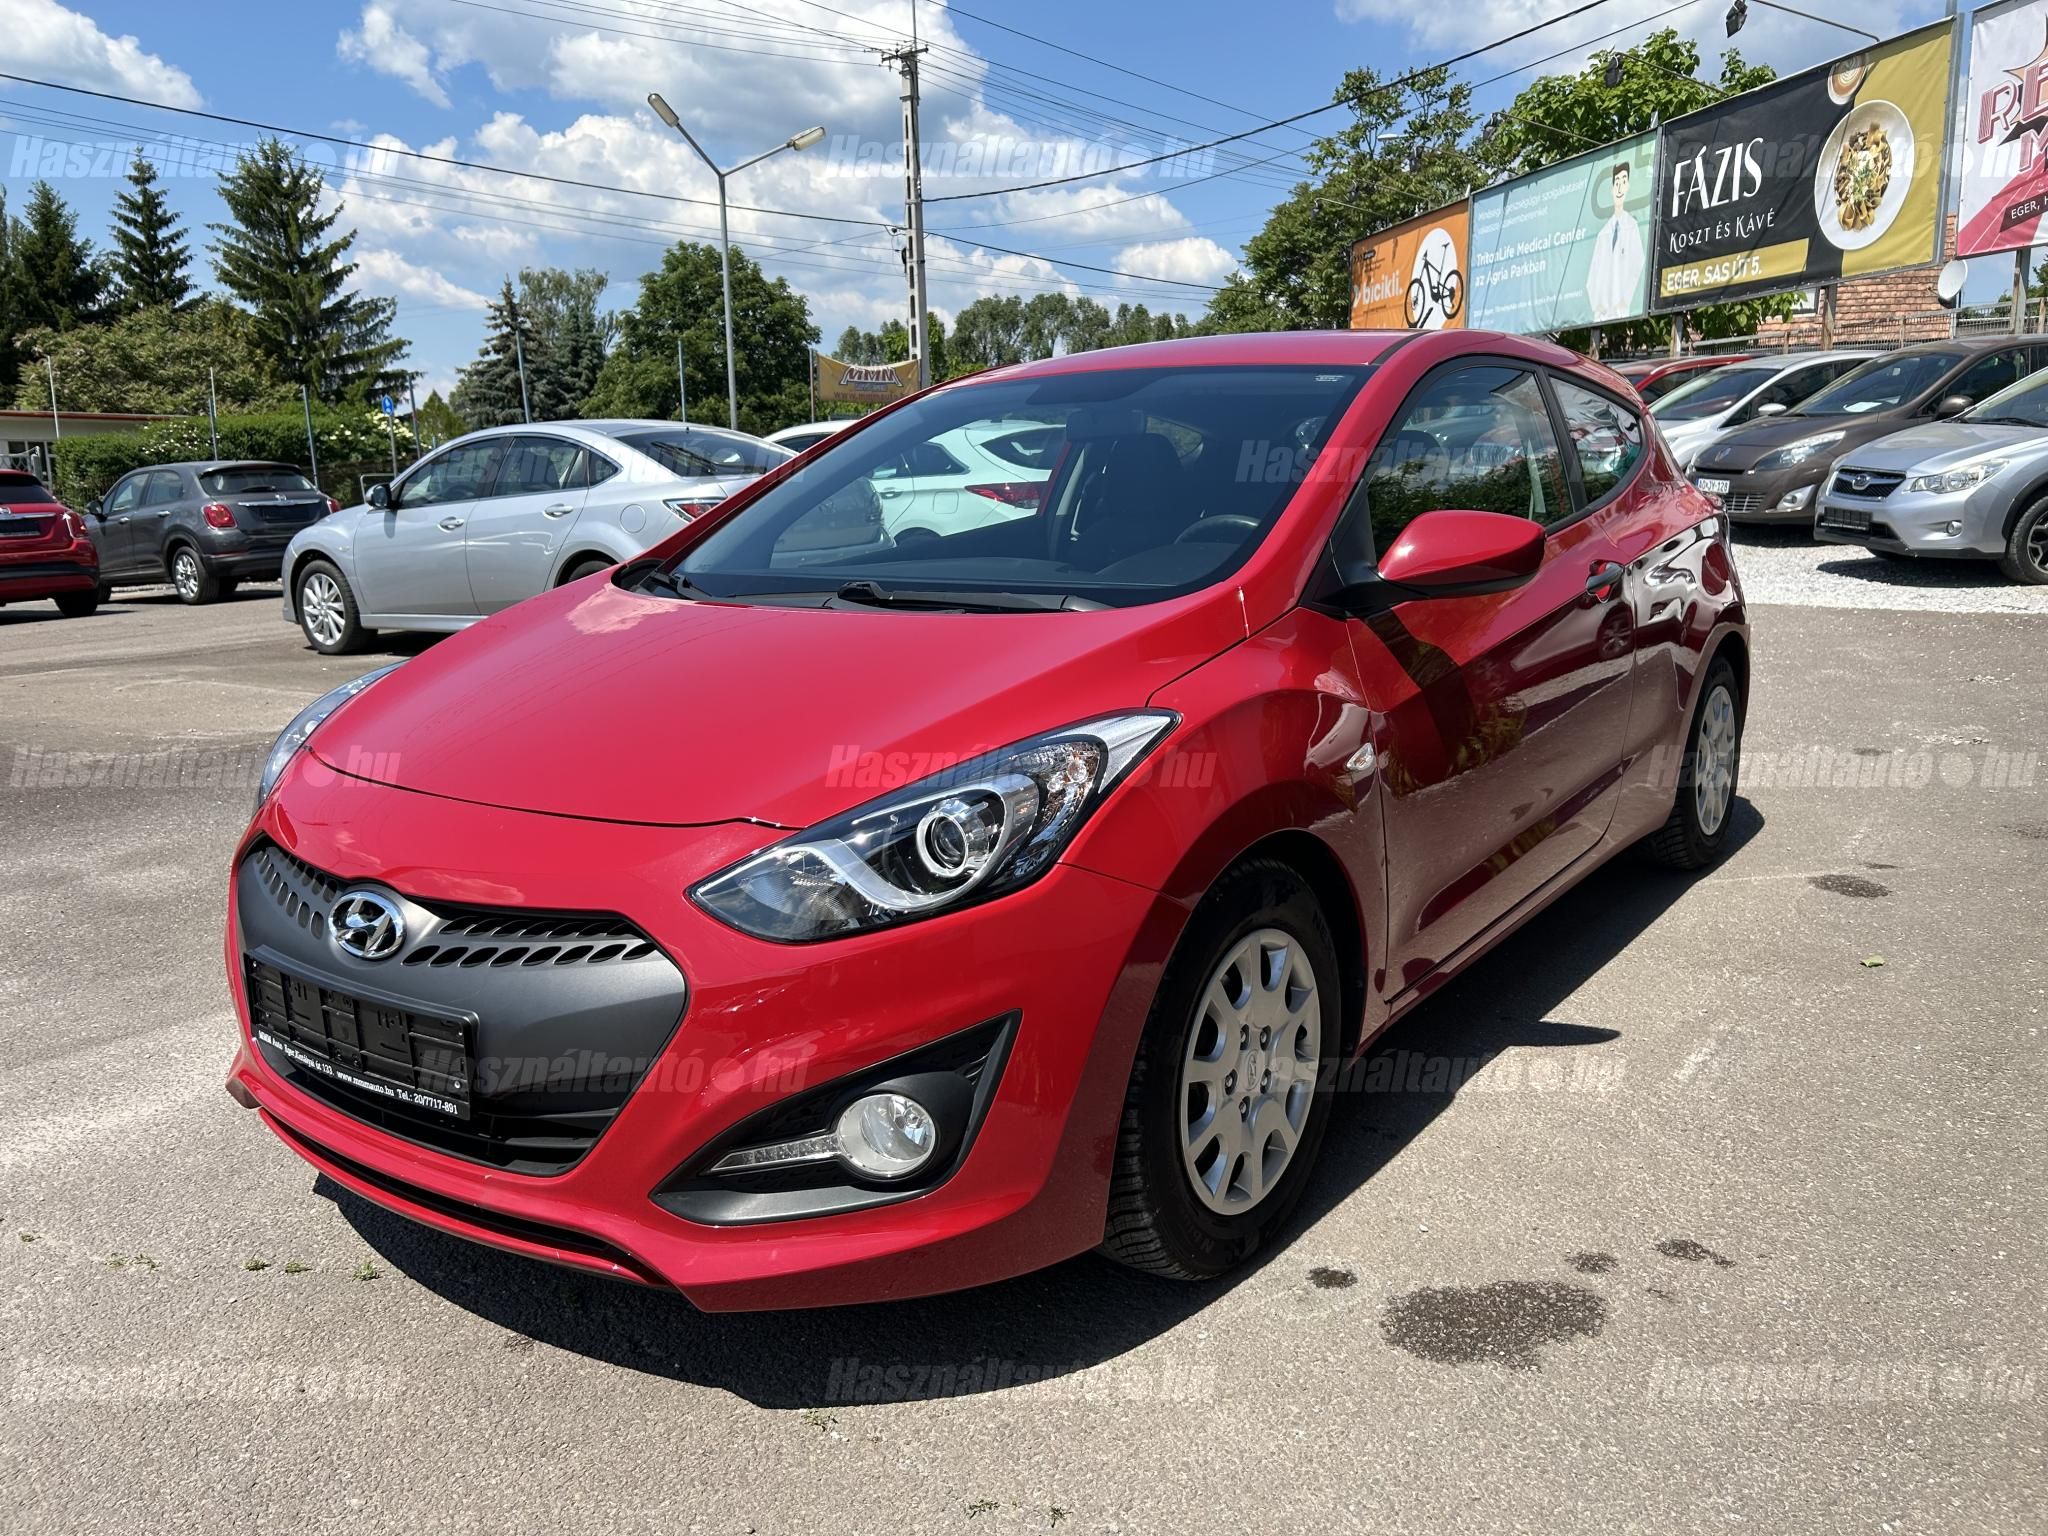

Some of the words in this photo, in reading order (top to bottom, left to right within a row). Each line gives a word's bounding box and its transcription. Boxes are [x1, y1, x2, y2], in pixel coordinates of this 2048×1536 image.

[1671, 137, 1764, 218] FÁZIS
[1735, 207, 1775, 239] KÁVÉ
[2011, 200, 2040, 220] EGER,
[1516, 232, 1551, 257] Medical
[1553, 226, 1587, 246] Center
[1475, 275, 1485, 288] az
[1487, 267, 1508, 286] Agria
[1510, 258, 1547, 279] Parkban
[1703, 261, 1730, 285] SAS
[1731, 255, 1751, 280] ÚT
[1751, 255, 1762, 276] 5.
[414, 1092, 458, 1115] 20/7717-891
